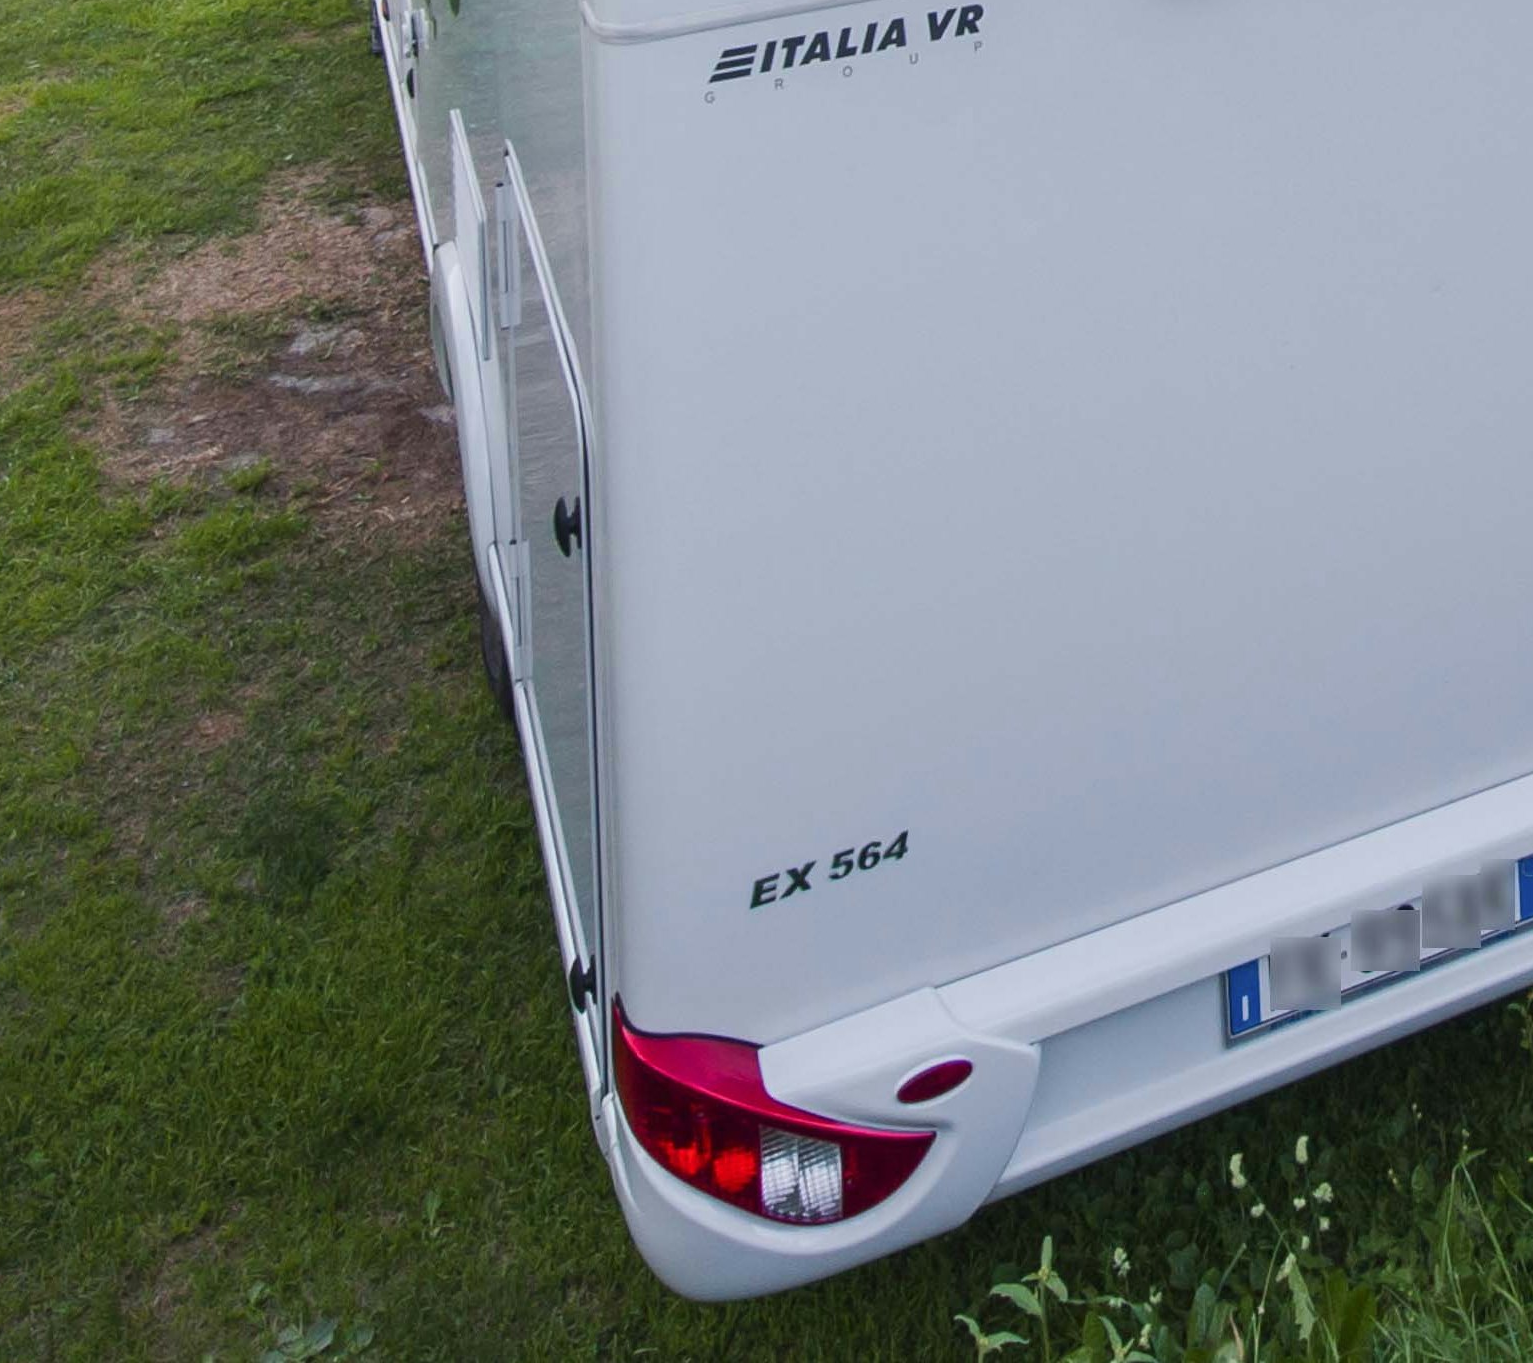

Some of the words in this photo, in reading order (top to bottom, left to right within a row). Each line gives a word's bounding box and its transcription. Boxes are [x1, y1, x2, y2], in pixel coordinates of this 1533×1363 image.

[758, 17, 907, 74] ITALIA
[926, 3, 984, 42] VR
[749, 859, 817, 910] EX
[827, 829, 909, 881] 564
